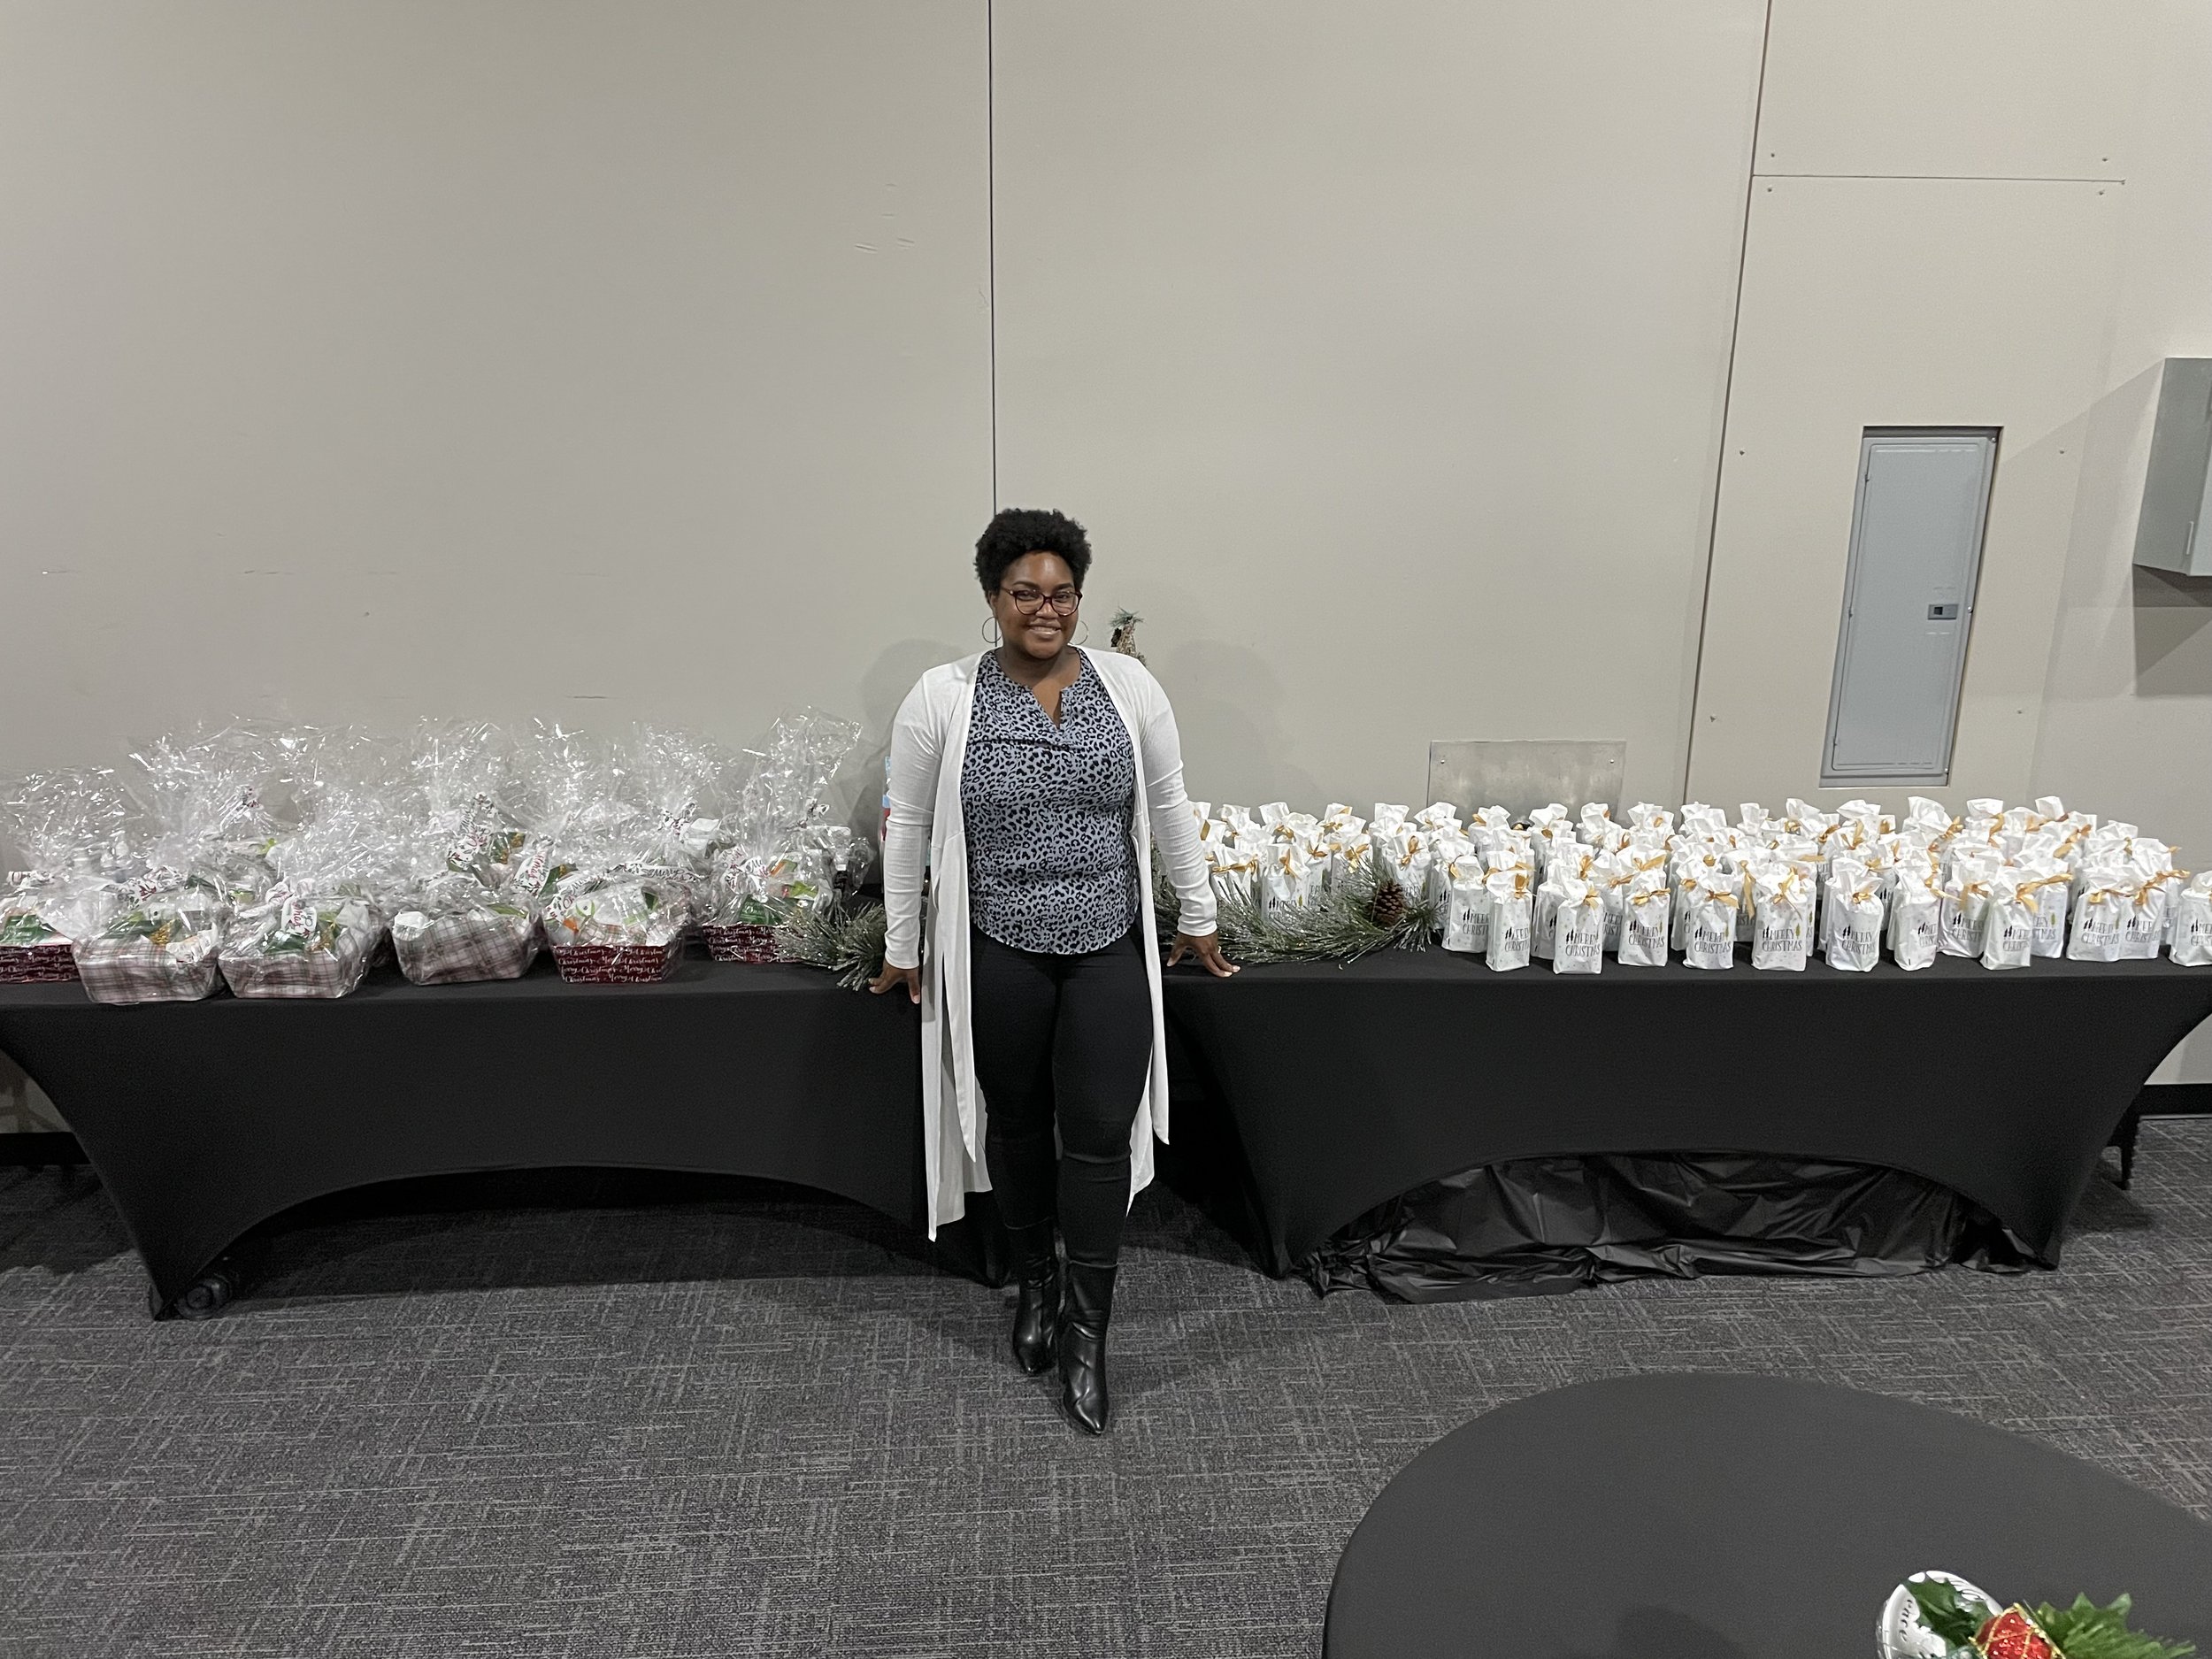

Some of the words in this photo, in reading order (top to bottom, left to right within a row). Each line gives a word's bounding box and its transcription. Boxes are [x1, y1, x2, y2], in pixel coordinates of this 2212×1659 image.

[1470, 912, 1490, 924] MERR
[1463, 924, 1489, 935] CHRIST
[1770, 928, 1794, 940] MERRY
[1505, 940, 1529, 952] CHRIST
[1629, 933, 1665, 949] CHRISTMAS
[1762, 940, 1802, 952] CHRISTMAS
[1565, 943, 1601, 957] CHRISTMAS
[1841, 939, 1875, 956] CHRISTM
